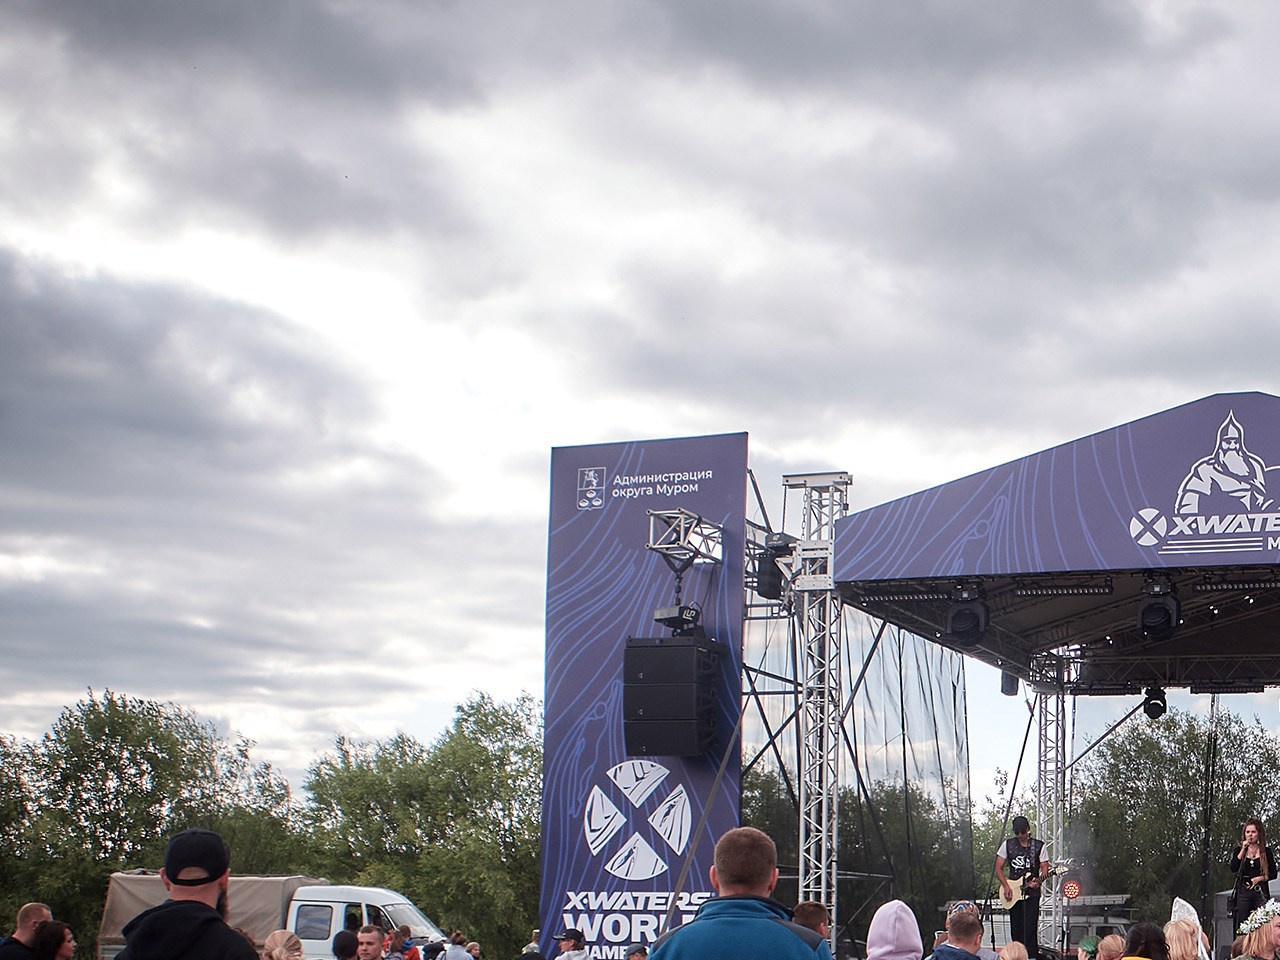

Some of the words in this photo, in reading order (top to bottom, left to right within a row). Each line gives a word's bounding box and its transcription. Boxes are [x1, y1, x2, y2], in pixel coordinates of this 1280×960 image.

[613, 470, 713, 486] Администрация
[612, 486, 653, 499] округа
[656, 483, 698, 496] Муром
[563, 913, 696, 942] WOR
